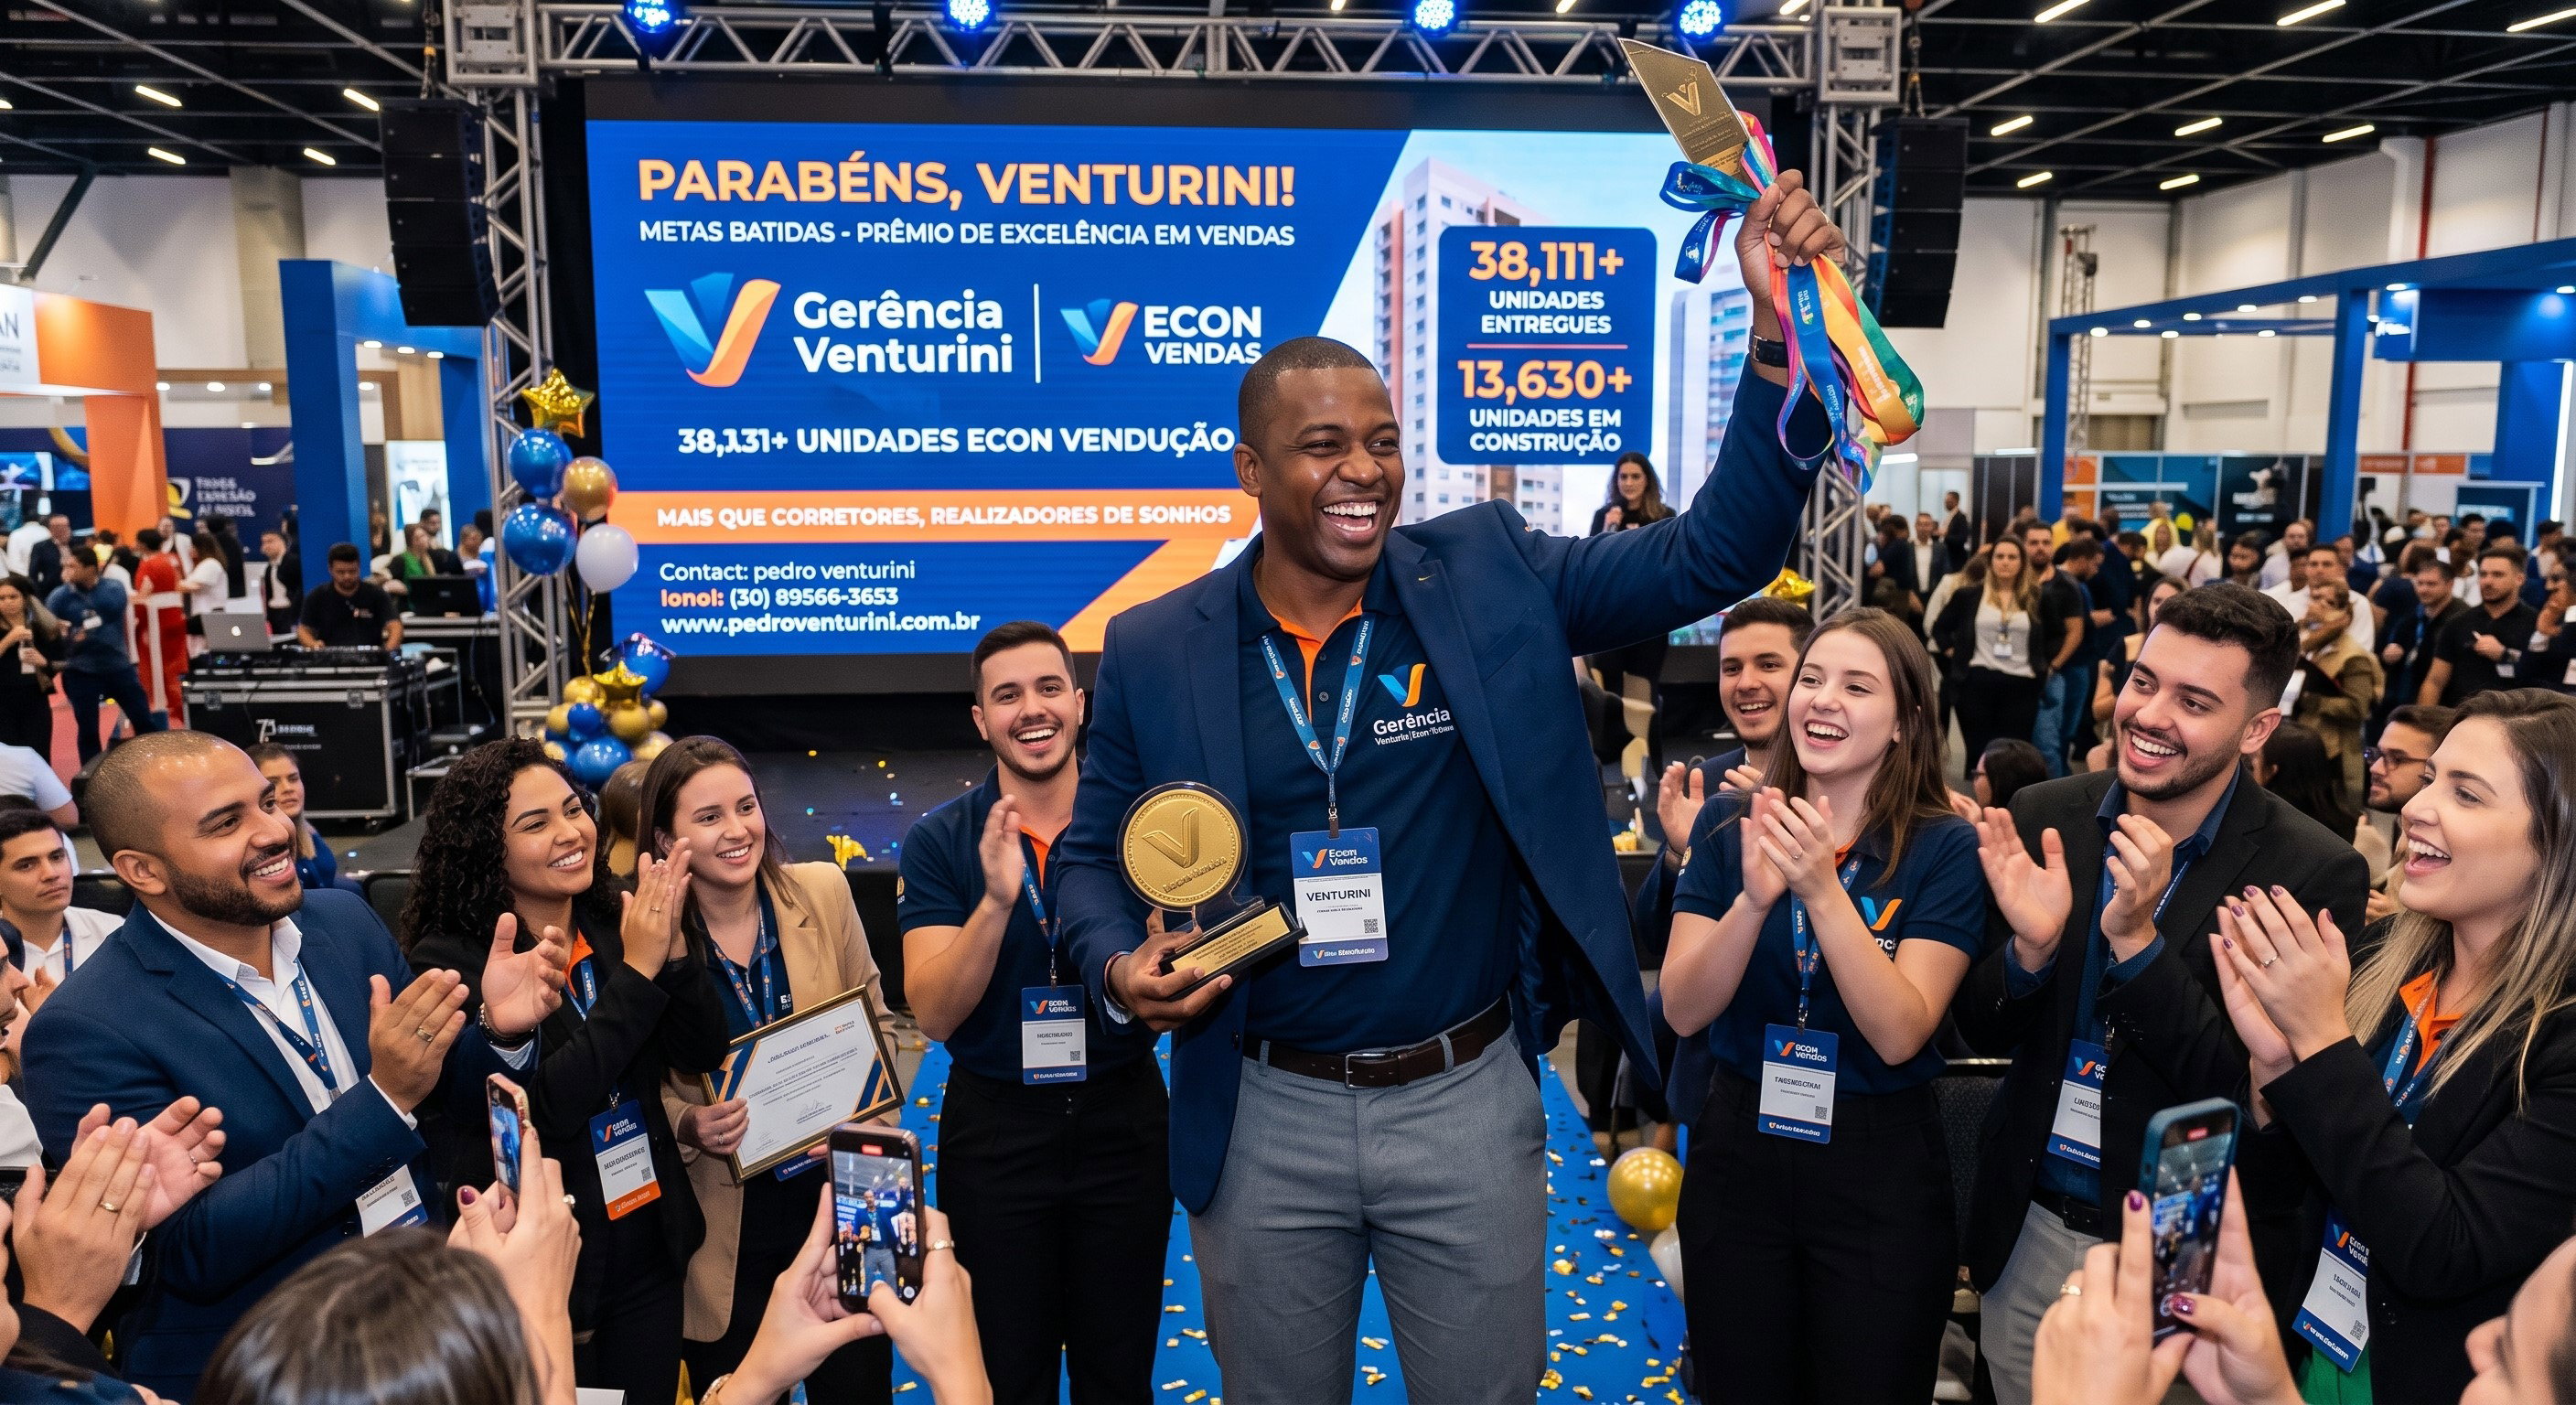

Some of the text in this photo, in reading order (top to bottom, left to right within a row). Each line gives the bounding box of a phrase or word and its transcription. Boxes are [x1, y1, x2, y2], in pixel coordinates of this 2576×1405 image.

[639, 151, 1295, 211] PARABÉNS, VENTURINI!
[639, 220, 724, 242] METAS
[729, 221, 836, 243] BATIDAS
[857, 218, 954, 244] PRÊMIO
[960, 222, 994, 244] DE
[1000, 219, 1150, 245] EXCELÊNCIA
[1154, 224, 1191, 245] EM
[1196, 225, 1295, 246] VENDAS
[1468, 241, 1625, 288] 38,111+
[793, 288, 1004, 329] Gerência
[1489, 290, 1605, 310] UNIDADES
[1144, 305, 1261, 338] ECON
[1481, 314, 1612, 335] ENTREGUES
[793, 332, 1013, 373] Venturini
[1143, 341, 1262, 365] VENDAS
[1457, 359, 1633, 406] 13,630+
[1469, 408, 1622, 428] UNIDADES EM
[796, 427, 960, 454] UNIDADES
[967, 427, 1053, 453] ECON
[1059, 421, 1236, 459] VENDUÇÃO
[1469, 429, 1622, 456] CONSTRUÇÃO
[657, 504, 1232, 531] MAIS QUE CORRETORES, REALIZADORES DE SONHOS
[660, 560, 916, 585] Contact: pedro venturini
[729, 587, 770, 611] (30)
[775, 586, 899, 606] 89566-3653
[660, 610, 981, 638] www.pedroventurini.com.br
[1373, 707, 1451, 735] Gerência
[1306, 888, 1371, 902] VENTURINI
